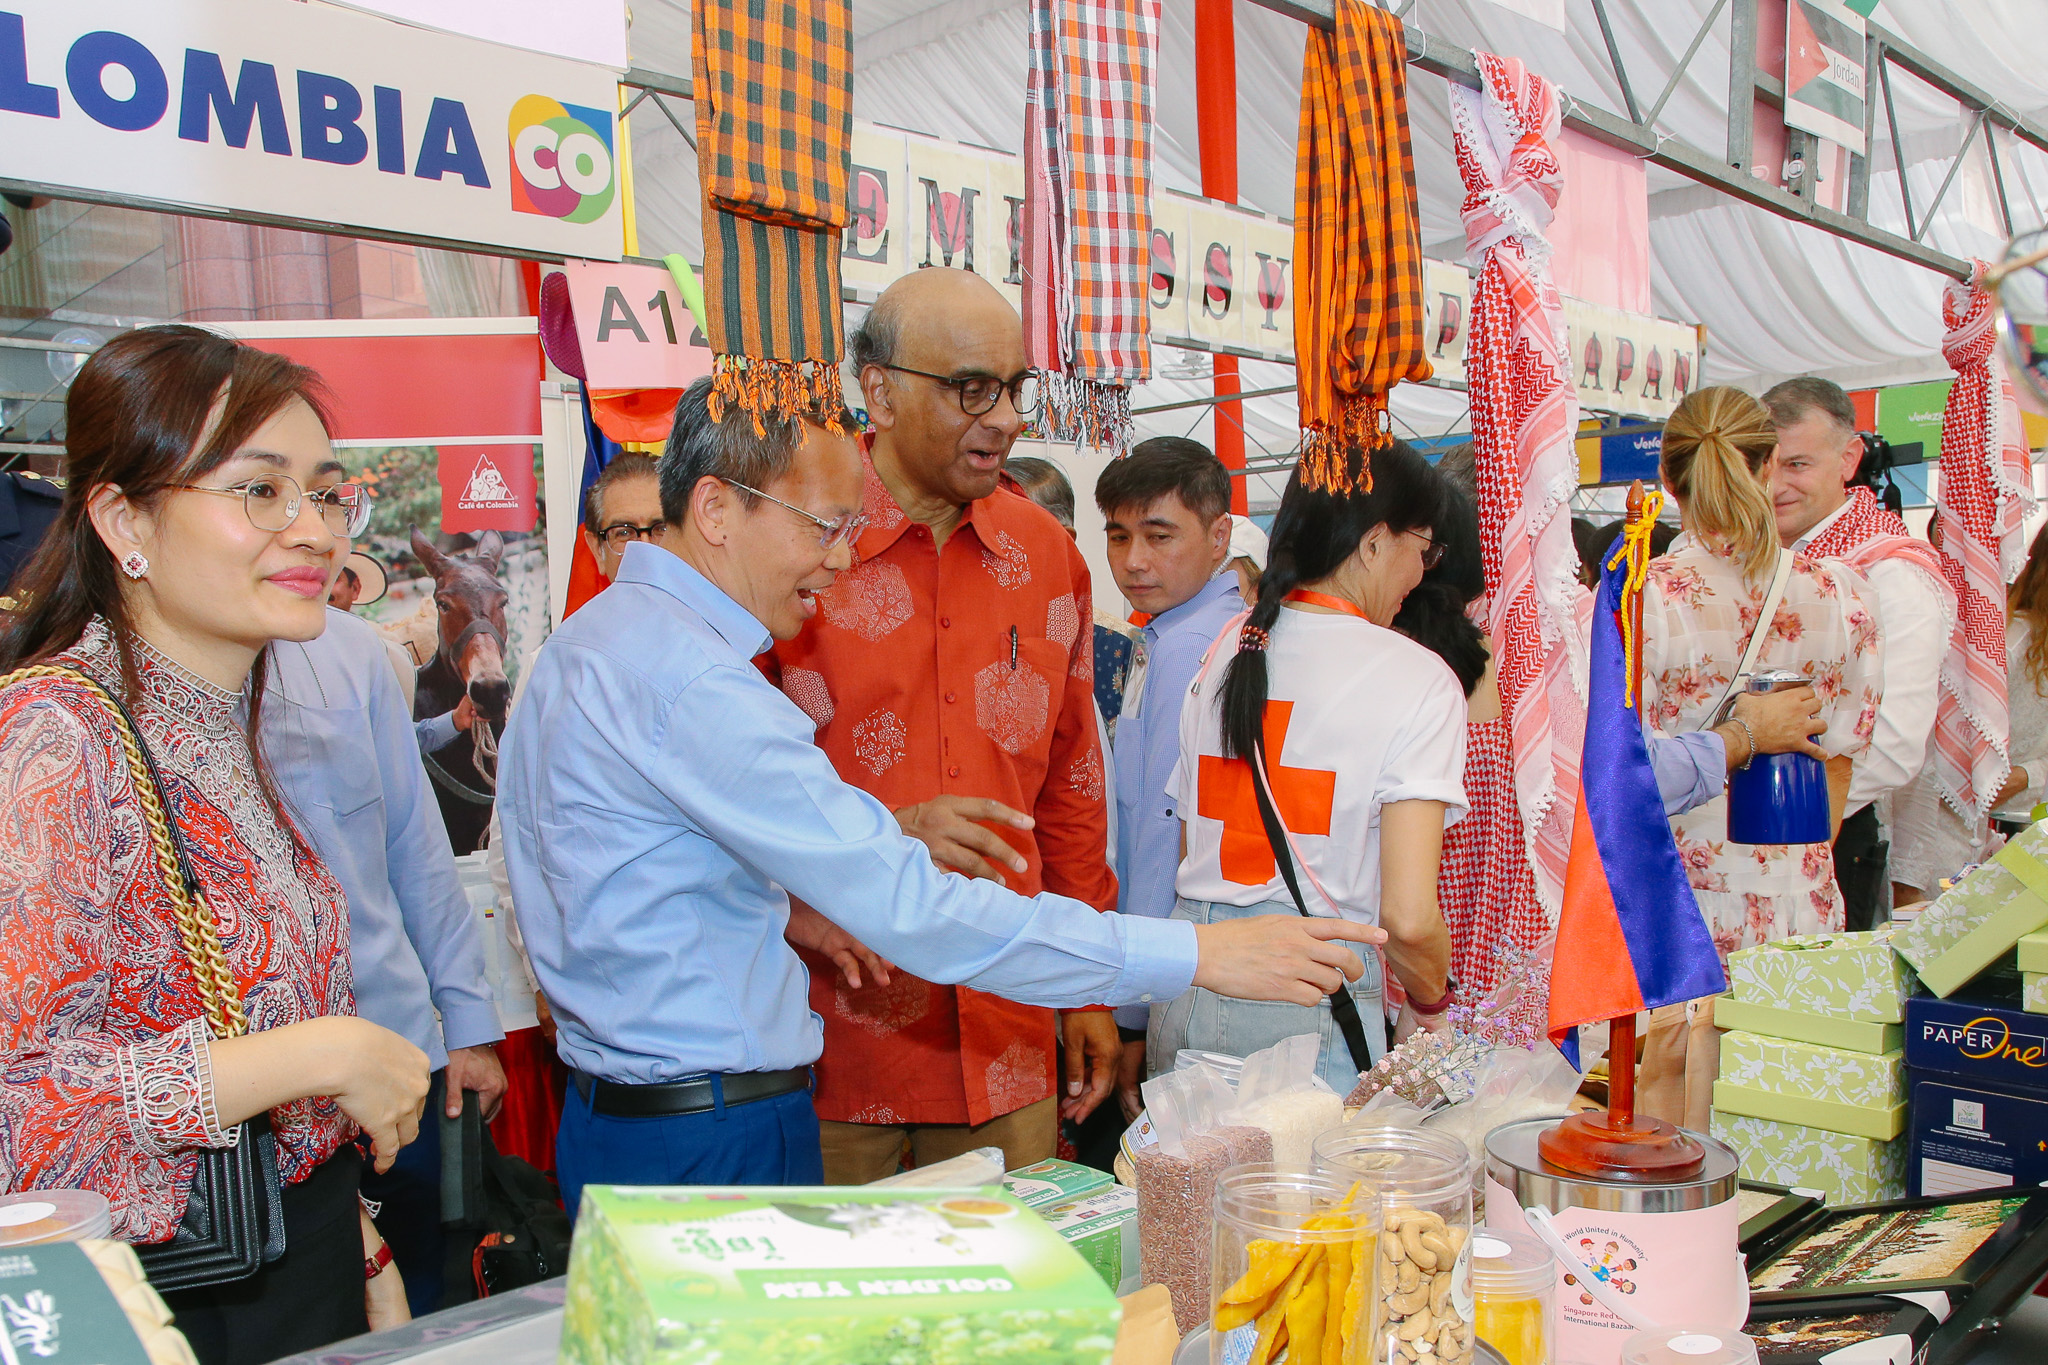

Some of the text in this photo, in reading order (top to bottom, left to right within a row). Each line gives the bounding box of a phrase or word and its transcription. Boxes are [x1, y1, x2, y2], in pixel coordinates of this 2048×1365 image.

[1833, 57, 1860, 89] Jordan
[514, 124, 612, 196] CO
[843, 163, 1290, 332] EMSSY
[1567, 325, 1694, 402] APAN
[458, 501, 475, 510] Café
[486, 501, 519, 509] Colombia
[1564, 1227, 1584, 1241] World
[1585, 1226, 1609, 1235] United
[1611, 1230, 1618, 1238] in
[857, 1277, 1014, 1298] GOLDEN
[1563, 1305, 1598, 1318] Singapore
[1600, 1312, 1614, 1320] Red
[1564, 1314, 1609, 1329] International
[1611, 1321, 1635, 1331] Bazaar
